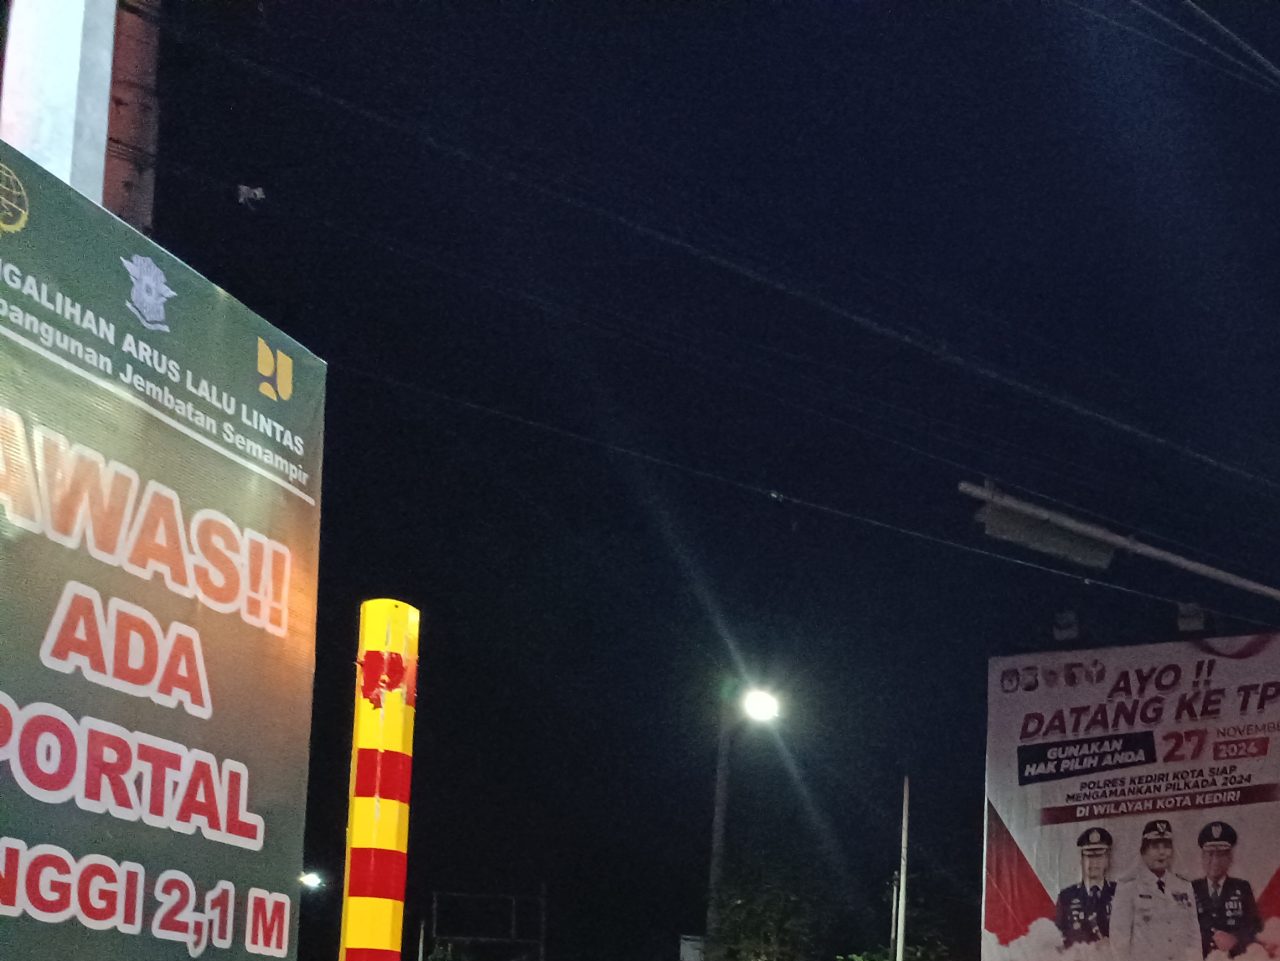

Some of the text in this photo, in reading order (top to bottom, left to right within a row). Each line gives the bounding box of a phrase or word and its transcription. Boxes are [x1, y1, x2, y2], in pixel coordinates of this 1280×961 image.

[0, 260, 305, 456] GALIHAN ARUS LALU LINTAS
[120, 363, 217, 434] Jembatan
[222, 422, 310, 486] Semampir
[40, 580, 212, 719] ADA
[1107, 663, 1181, 699] AYO
[1019, 698, 1164, 740] DATANG
[1174, 688, 1226, 722] KE
[1025, 749, 1145, 776] HAK PILIH ANDA
[1047, 739, 1123, 759] GUNAKAN
[1162, 728, 1208, 763] 27
[1065, 774, 1252, 803] MENGAMANKAN PILKADA 2024
[1079, 765, 1237, 792] POLRES KEDIRI KOTA SIAP
[1076, 791, 1241, 818] DI WILAYAH KOTA KEDIRI
[152, 869, 234, 958] 2,1
[245, 887, 290, 958] M
